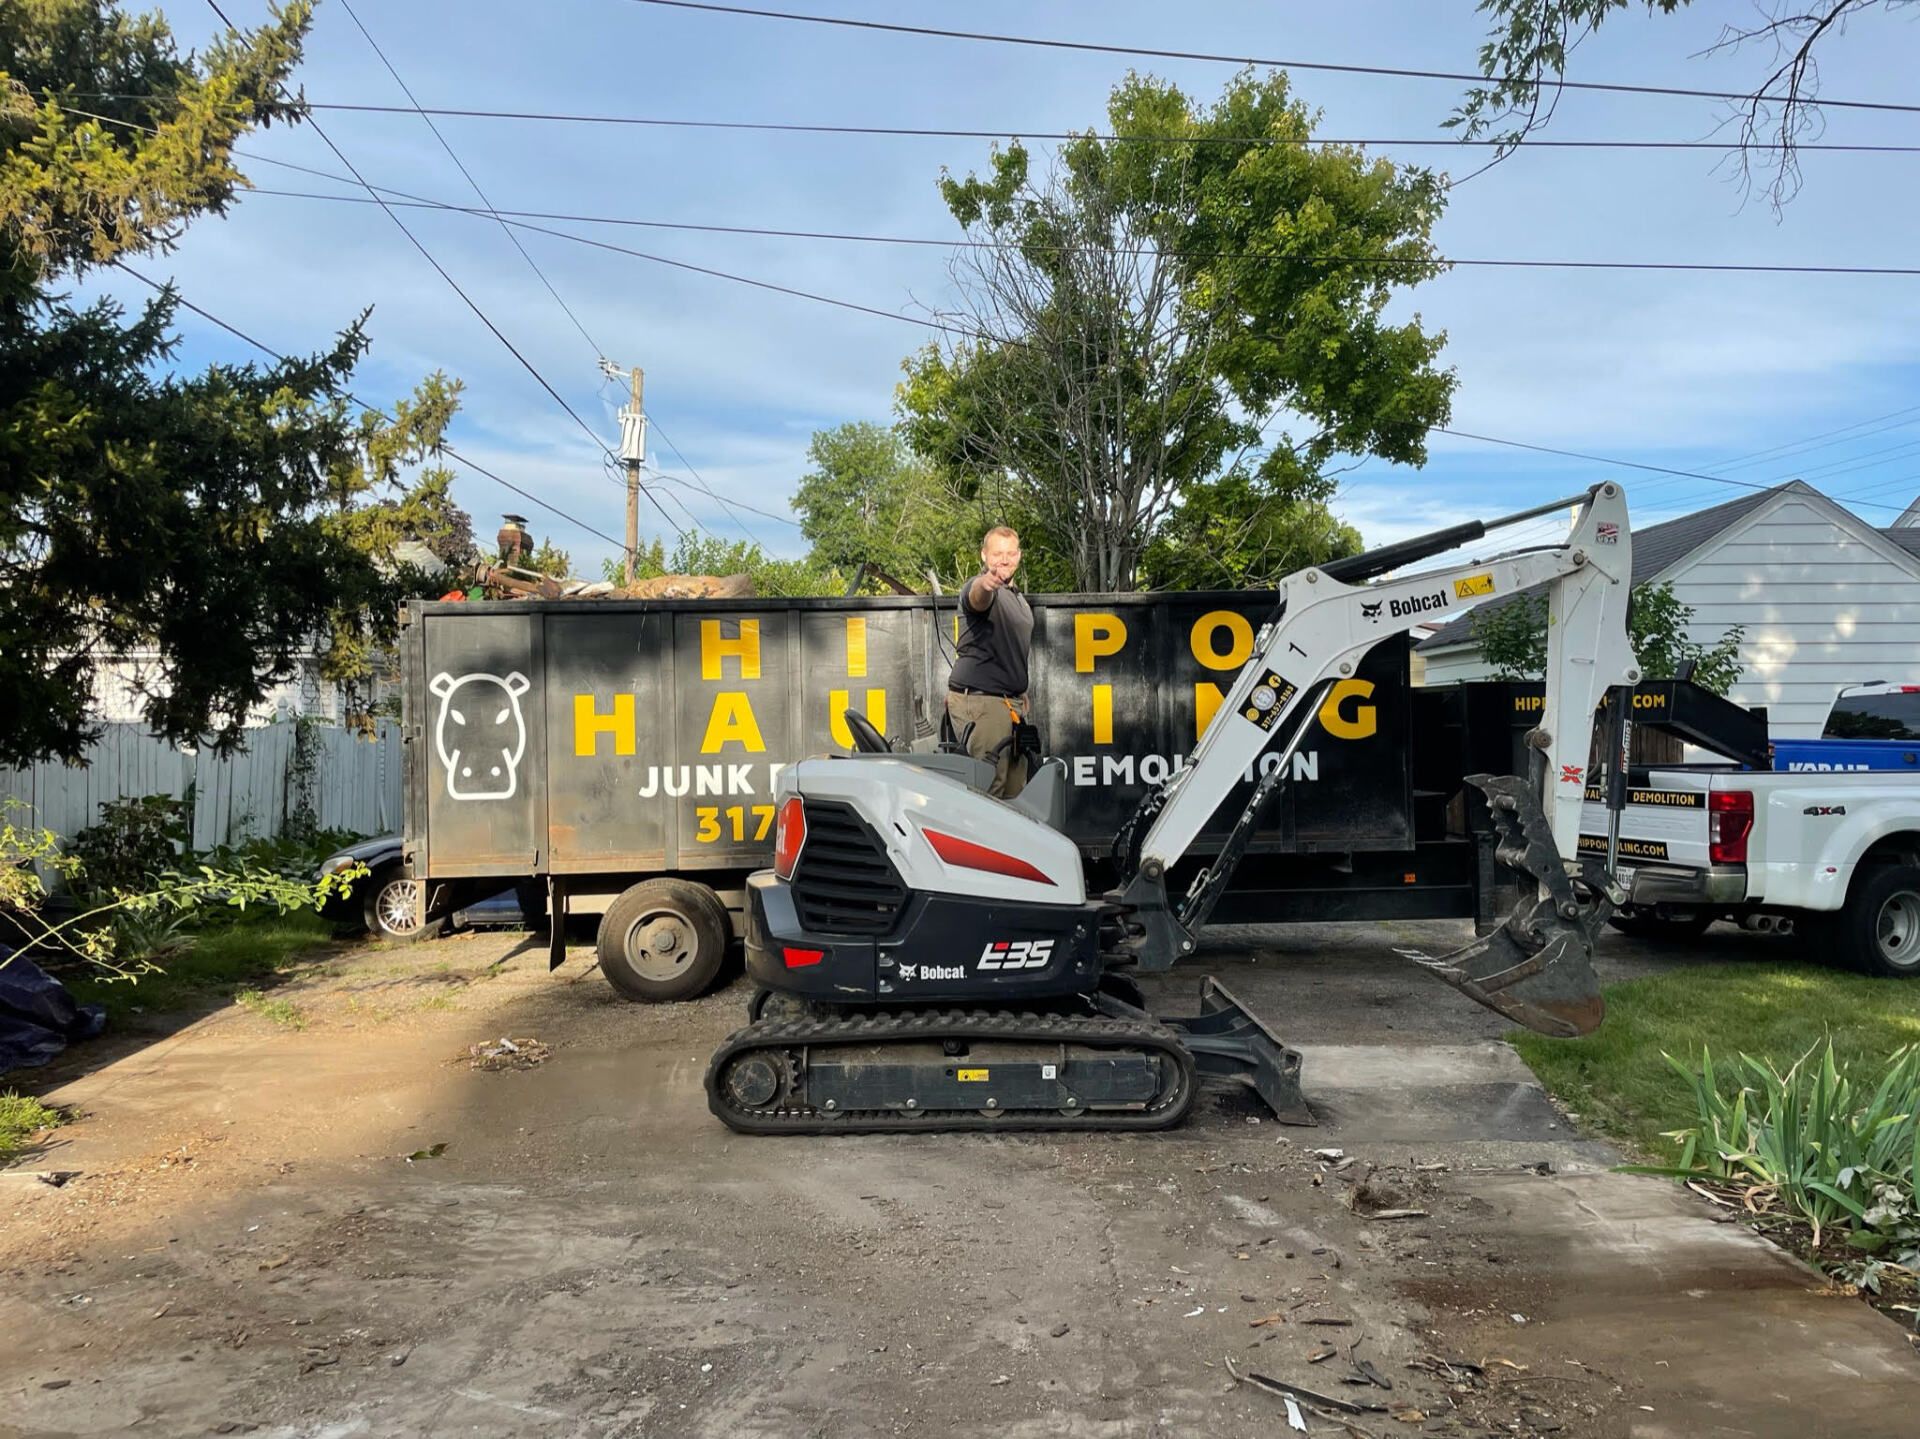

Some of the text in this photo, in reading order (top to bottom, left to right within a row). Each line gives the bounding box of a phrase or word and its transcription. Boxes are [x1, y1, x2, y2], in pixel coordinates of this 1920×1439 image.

[1389, 590, 1449, 617] Bobcat
[638, 763, 755, 798] JUNK
[1633, 791, 1695, 805] DEMOLITION
[977, 939, 1055, 971] E35
[920, 964, 968, 981] Bobcat
